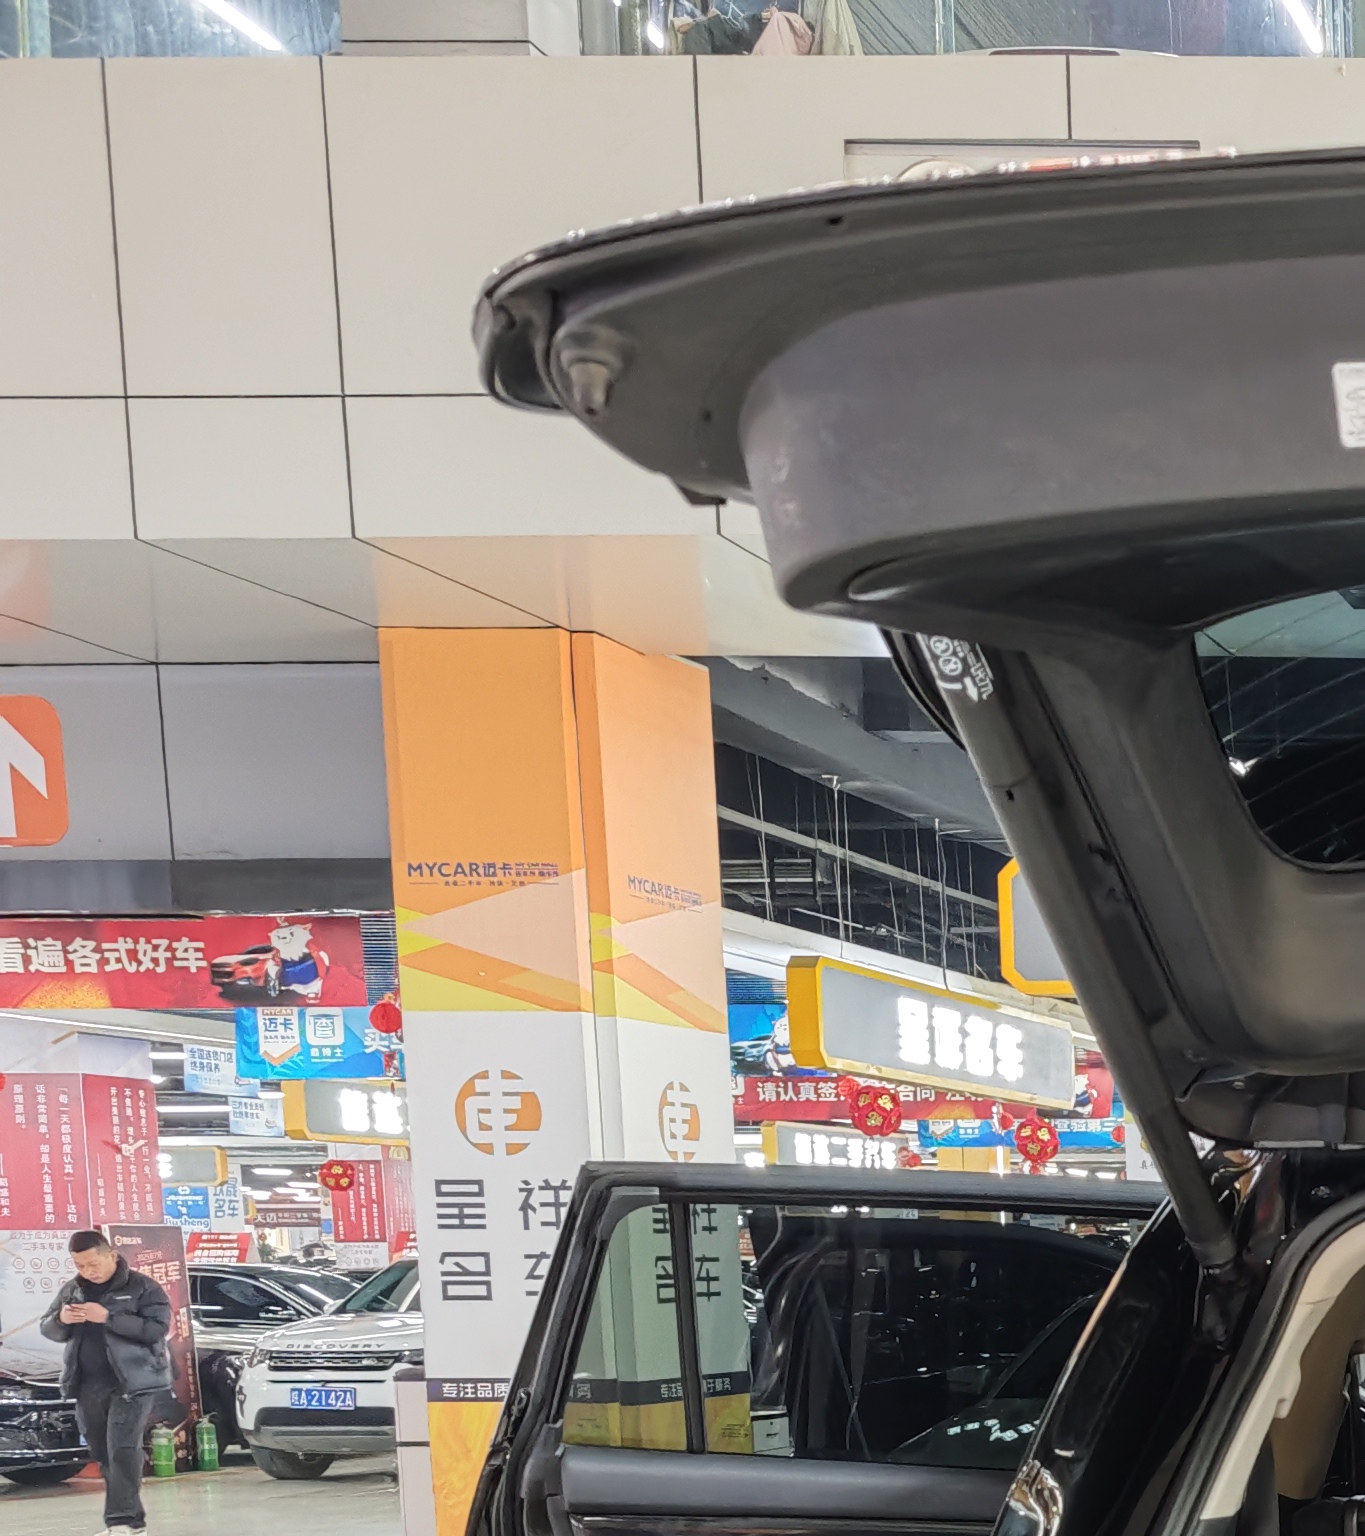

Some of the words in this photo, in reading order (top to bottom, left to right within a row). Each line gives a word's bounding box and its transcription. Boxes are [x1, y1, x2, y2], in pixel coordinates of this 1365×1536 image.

[0, 937, 207, 973] 看遍各式好车
[262, 1017, 295, 1032] 迈卡
[434, 1179, 573, 1231] 呈祥
[286, 1342, 387, 1350] DISCOVERY
[441, 1382, 509, 1398] 专注品质
